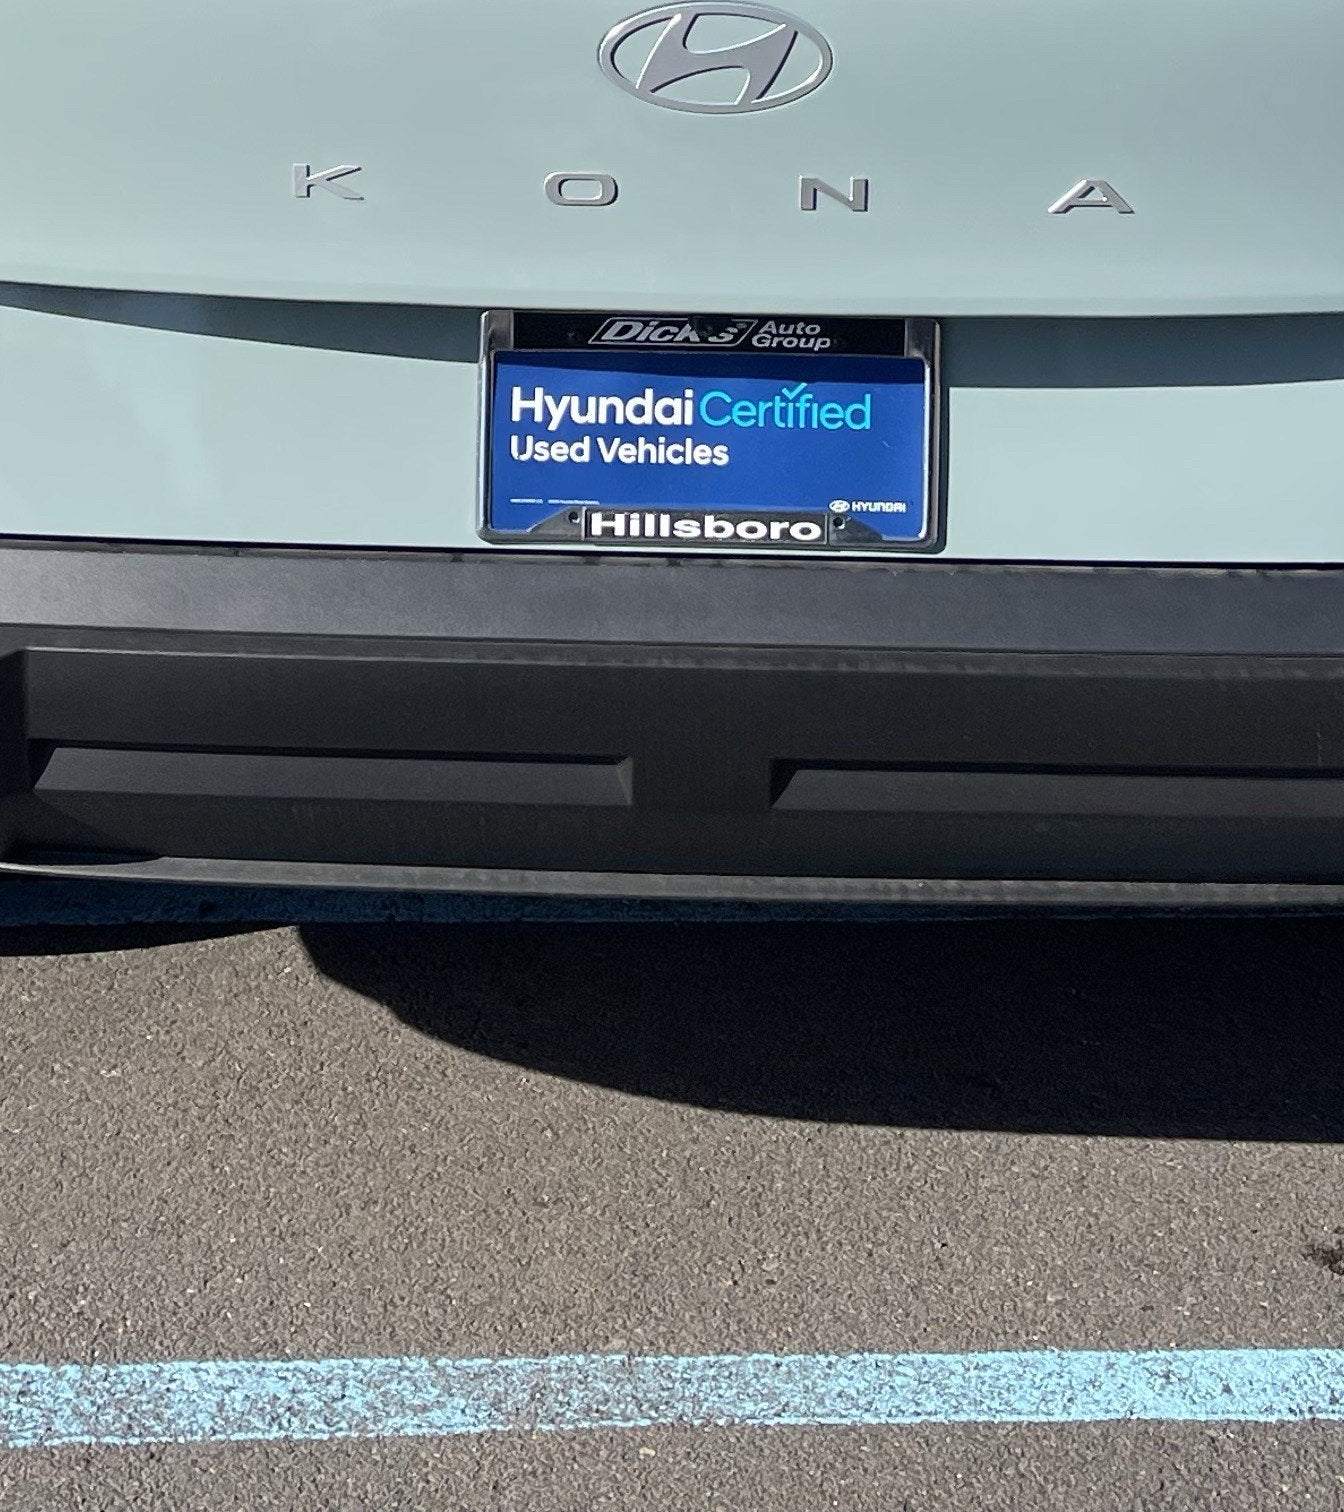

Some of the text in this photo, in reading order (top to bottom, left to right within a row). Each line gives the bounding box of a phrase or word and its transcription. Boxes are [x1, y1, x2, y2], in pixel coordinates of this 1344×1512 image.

[291, 161, 1136, 215] KONA
[751, 333, 831, 351] Group
[759, 320, 821, 336] Auto
[511, 383, 872, 431] Hyundai Certified
[510, 435, 730, 466] Used Vehicles
[851, 501, 907, 513] HYUNDAI
[591, 512, 822, 542] Hillsboro
